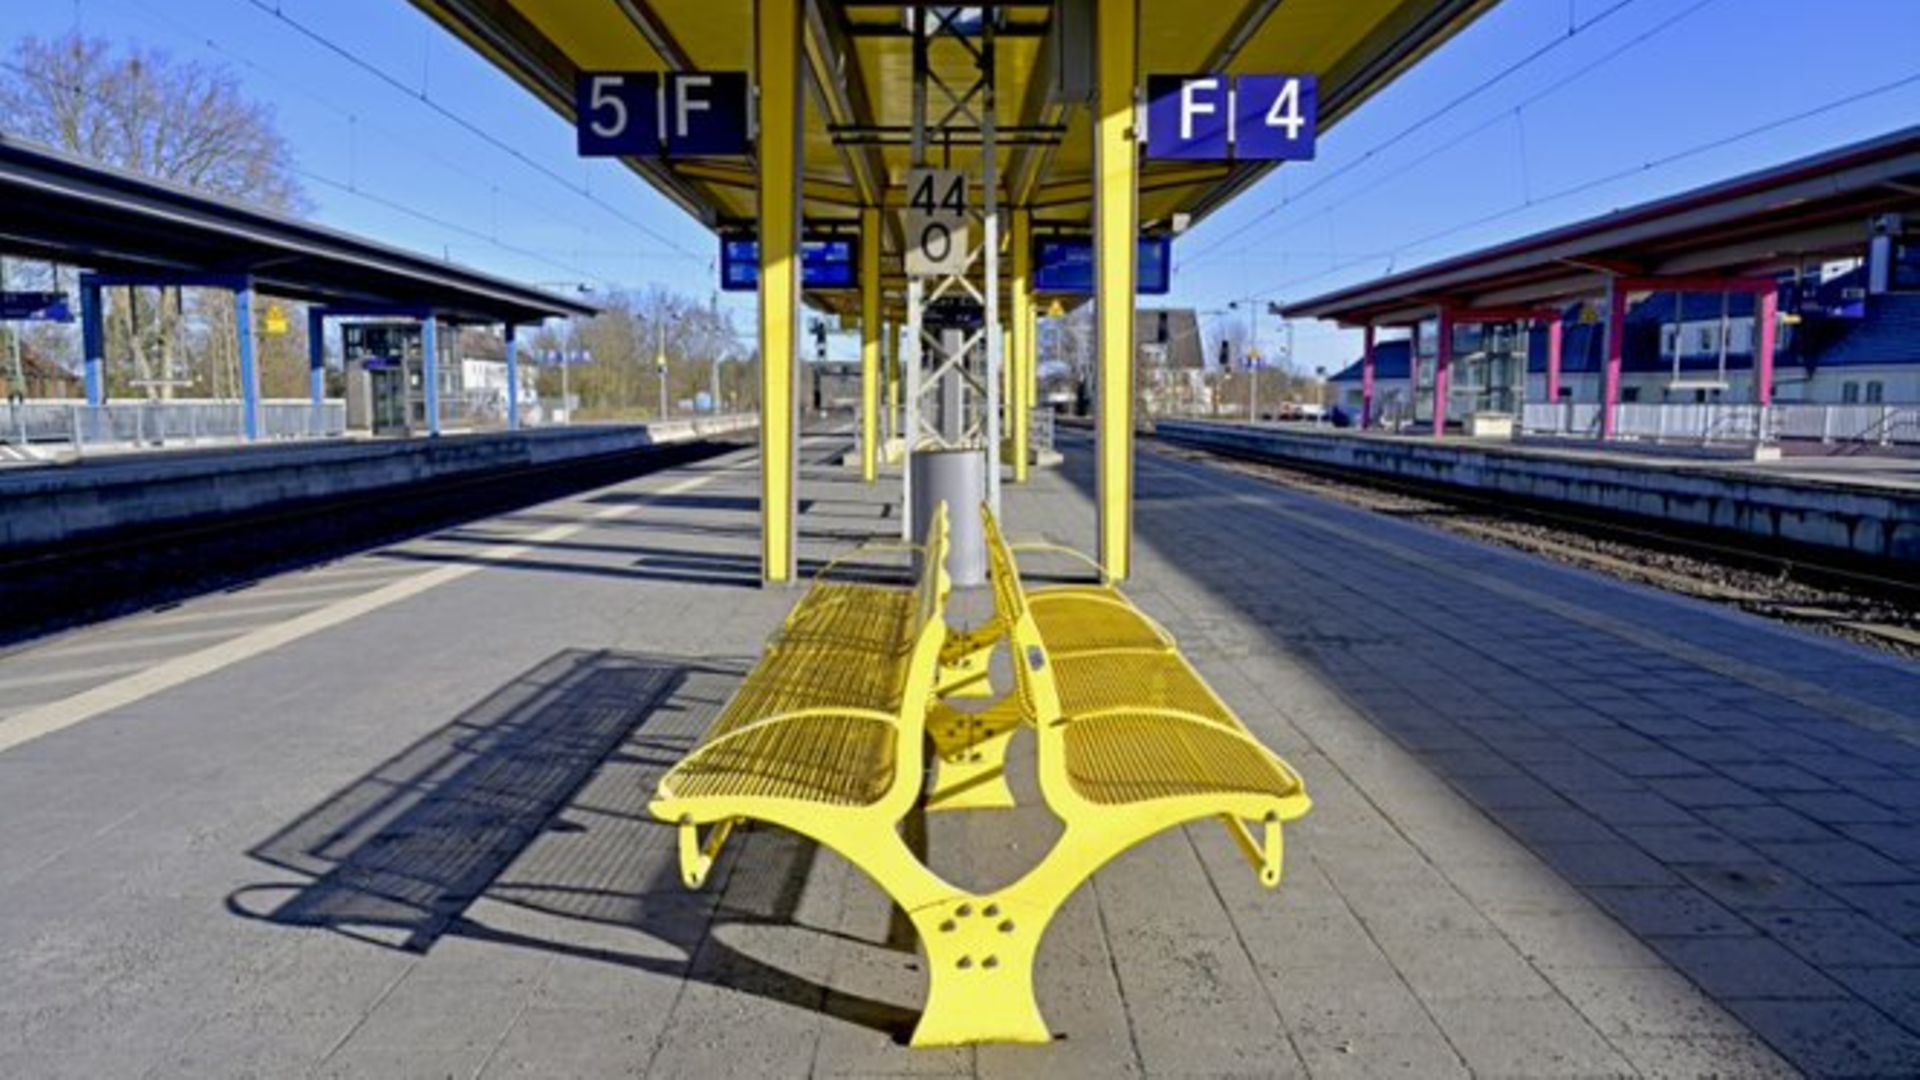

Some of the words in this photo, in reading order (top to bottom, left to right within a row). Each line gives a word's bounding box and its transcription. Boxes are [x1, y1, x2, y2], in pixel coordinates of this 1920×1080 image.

[591, 76, 627, 137] 5
[676, 76, 711, 136] F
[1180, 79, 1218, 140] F
[1265, 78, 1305, 140] 4
[911, 174, 967, 217] 44
